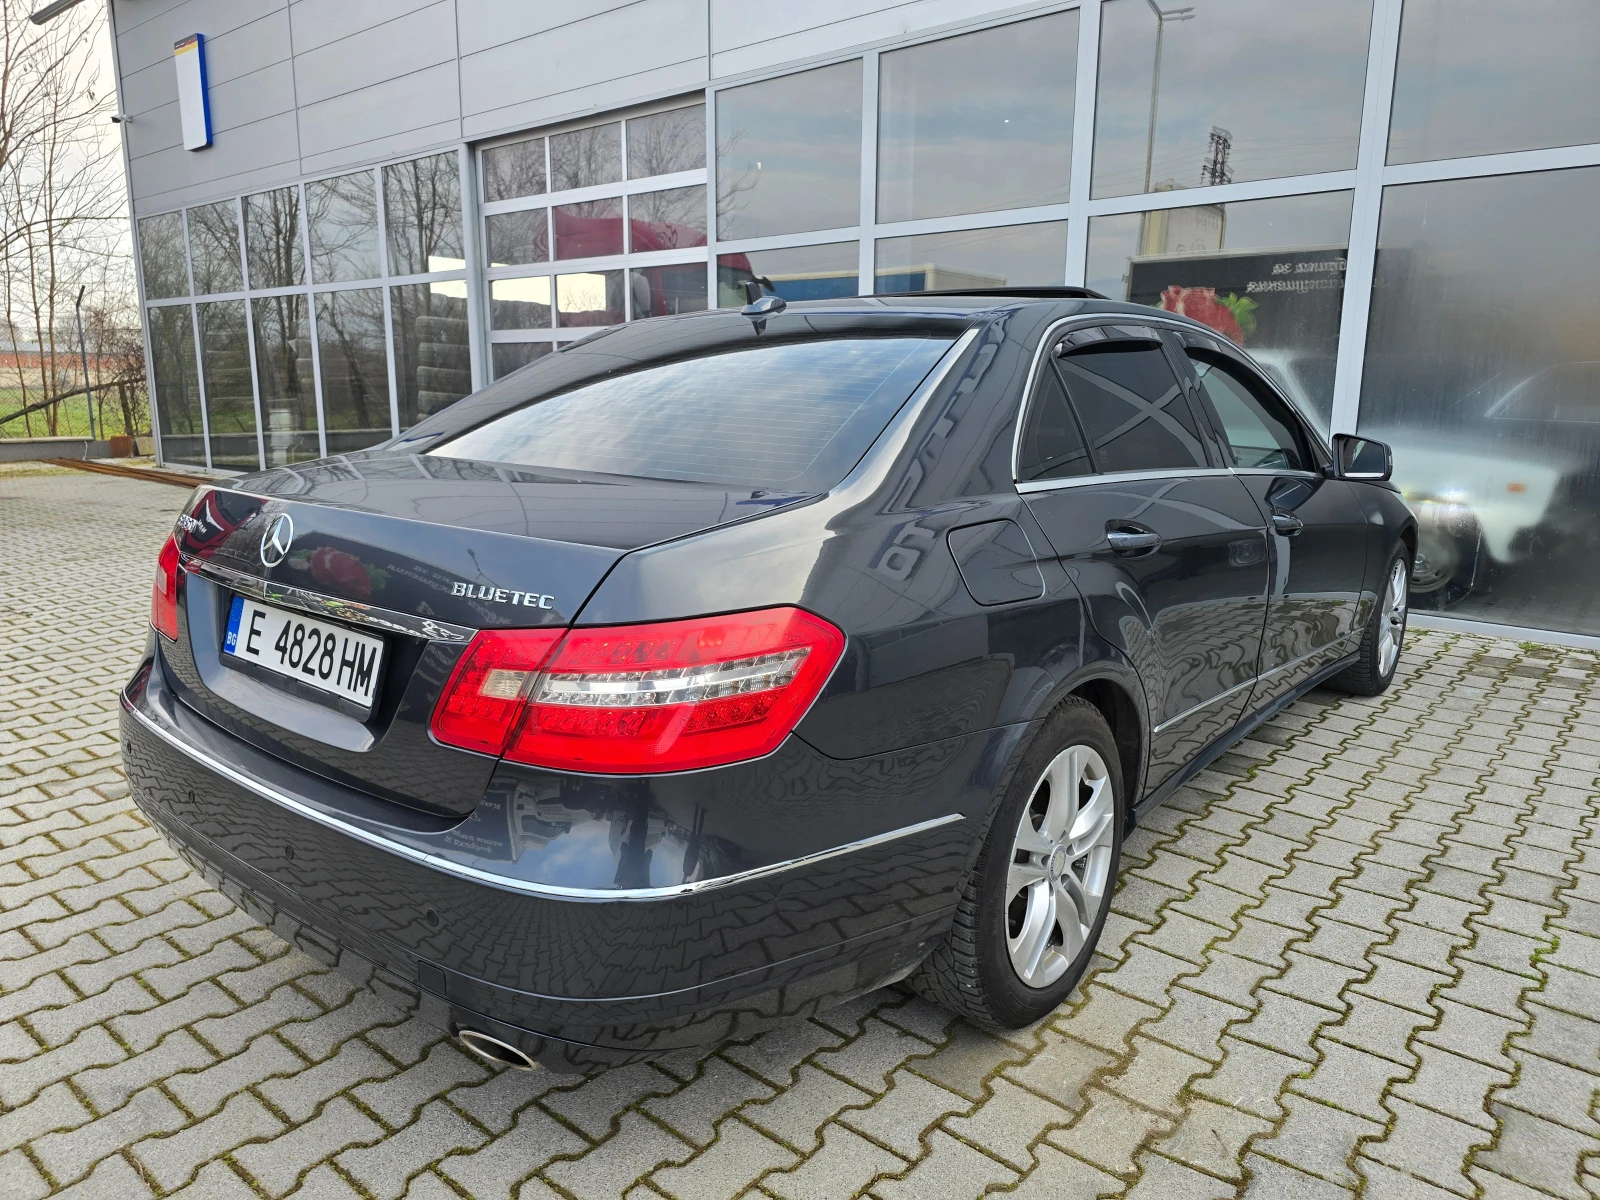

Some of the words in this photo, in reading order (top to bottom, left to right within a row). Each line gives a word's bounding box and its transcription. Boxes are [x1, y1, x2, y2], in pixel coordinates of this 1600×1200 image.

[451, 581, 555, 610] BLUETEC
[226, 631, 237, 646] BG
[246, 609, 266, 656] E
[274, 619, 337, 681] 4828
[336, 637, 377, 697] HM
